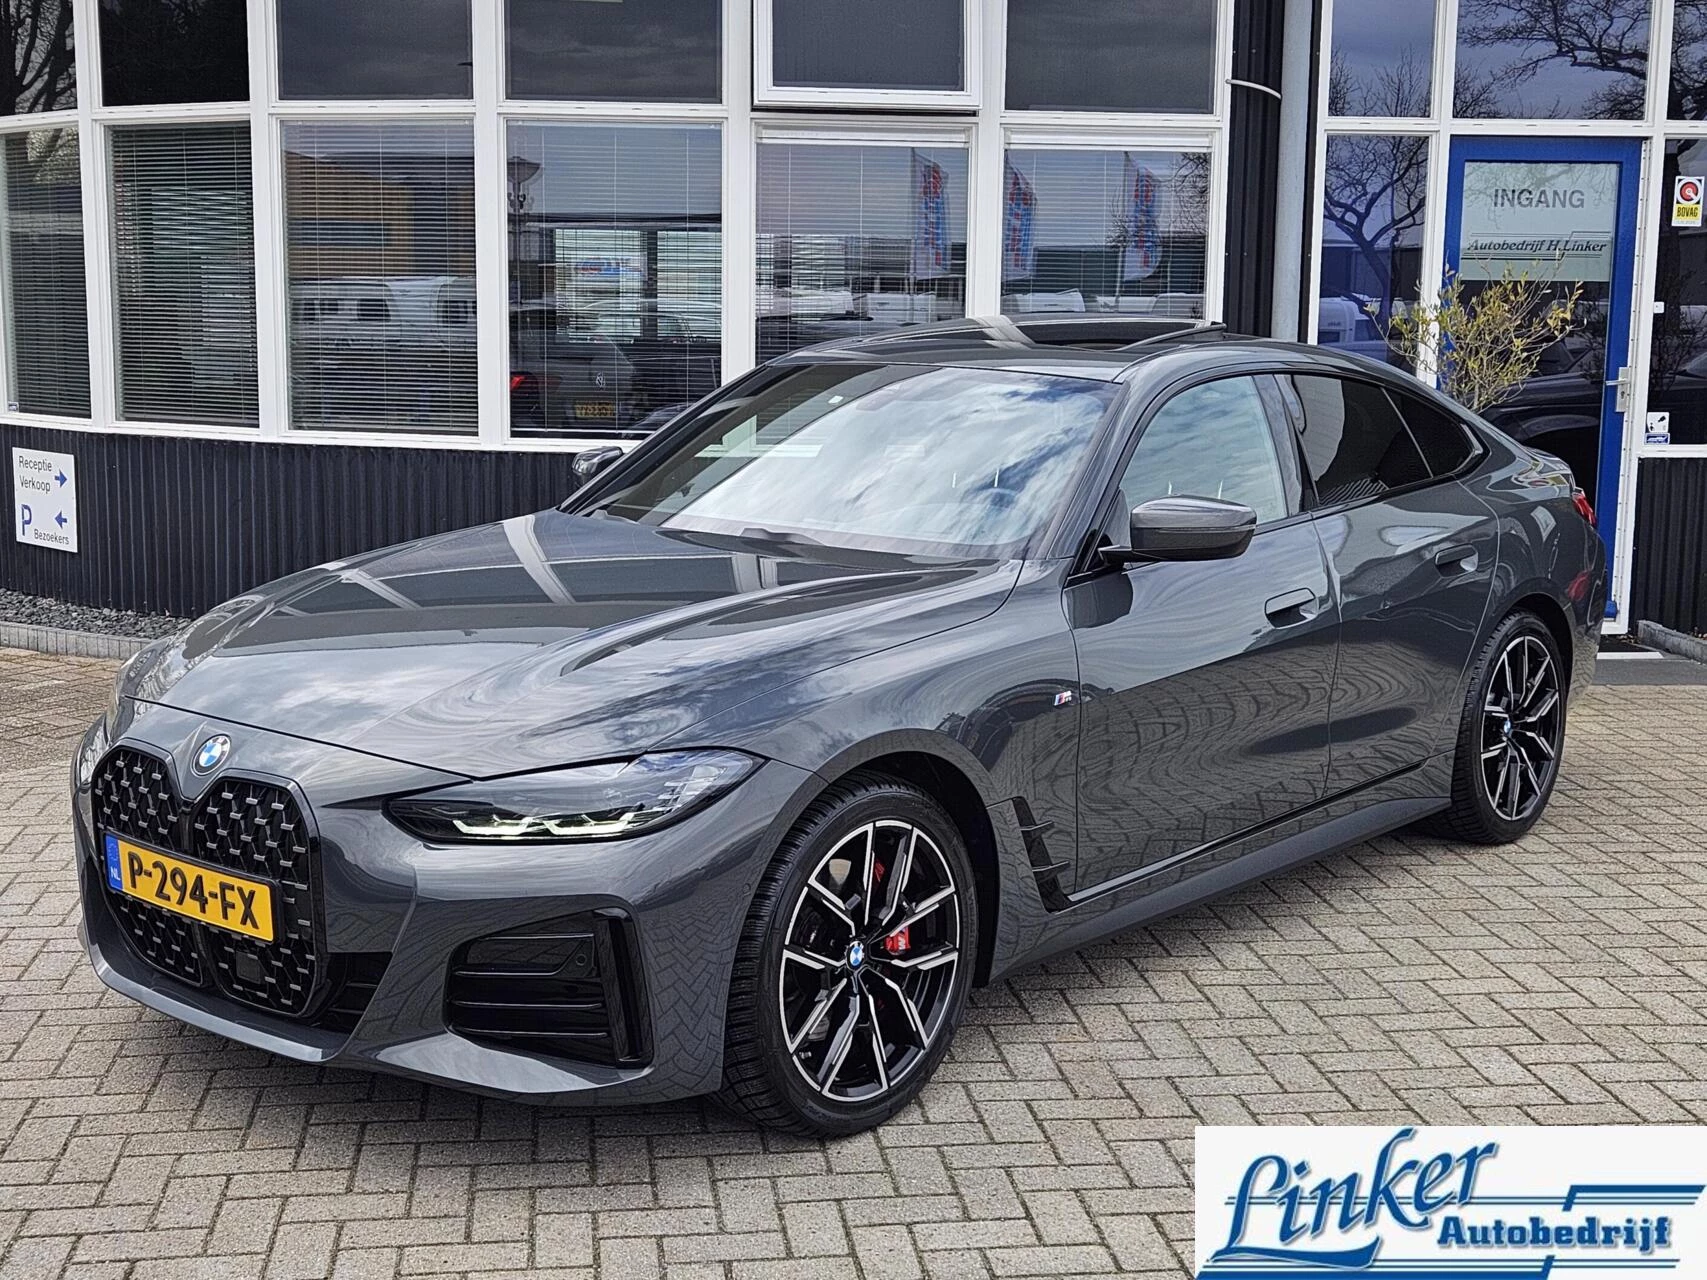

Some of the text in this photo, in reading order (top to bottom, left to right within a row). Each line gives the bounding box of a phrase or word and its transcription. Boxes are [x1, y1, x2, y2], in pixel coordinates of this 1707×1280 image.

[1494, 189, 1585, 208] INGANG
[1676, 206, 1699, 217] BOVAG
[1468, 238, 1546, 253] Autobedrijf
[18, 455, 52, 472] Receptie
[19, 475, 50, 493] Verkoop
[34, 528, 70, 545] Bezoekers
[110, 867, 121, 881] NL
[128, 850, 260, 930] P-294-FX
